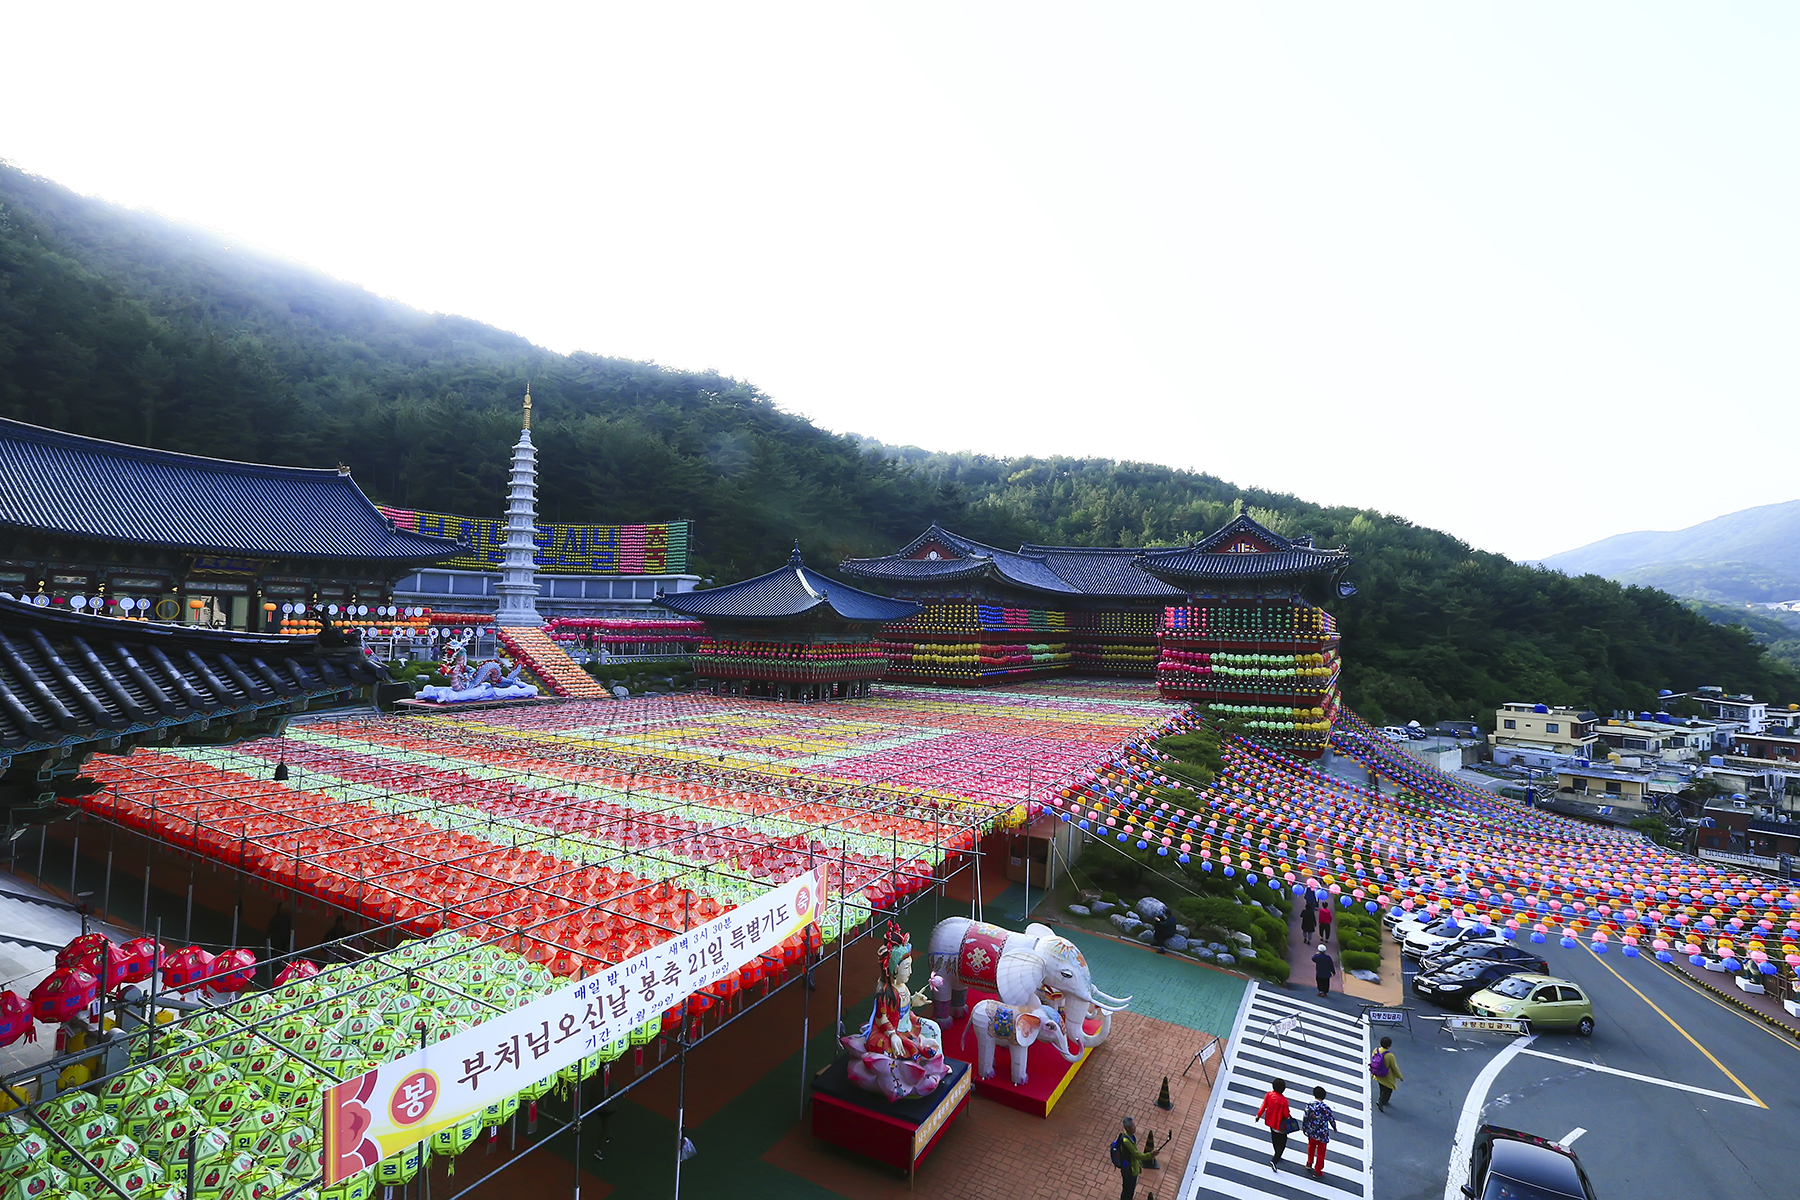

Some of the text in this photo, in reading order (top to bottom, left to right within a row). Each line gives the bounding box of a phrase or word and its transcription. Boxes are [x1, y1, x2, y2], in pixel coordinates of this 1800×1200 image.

[644, 527, 667, 566] 축
[796, 890, 809, 911] 축
[574, 978, 600, 1000] 매일
[607, 970, 619, 986] 밤
[625, 956, 649, 978] 10시
[668, 938, 689, 956] 새벽
[693, 928, 708, 944] 3시
[712, 916, 732, 934] 30분
[457, 903, 789, 1092] 부처님오신날 봉축 21일 특별기도
[585, 1028, 611, 1050] 기간
[627, 1009, 646, 1026] 4월
[651, 993, 674, 1014] 29일
[711, 962, 729, 979] 19일
[396, 1077, 433, 1118] 봉
